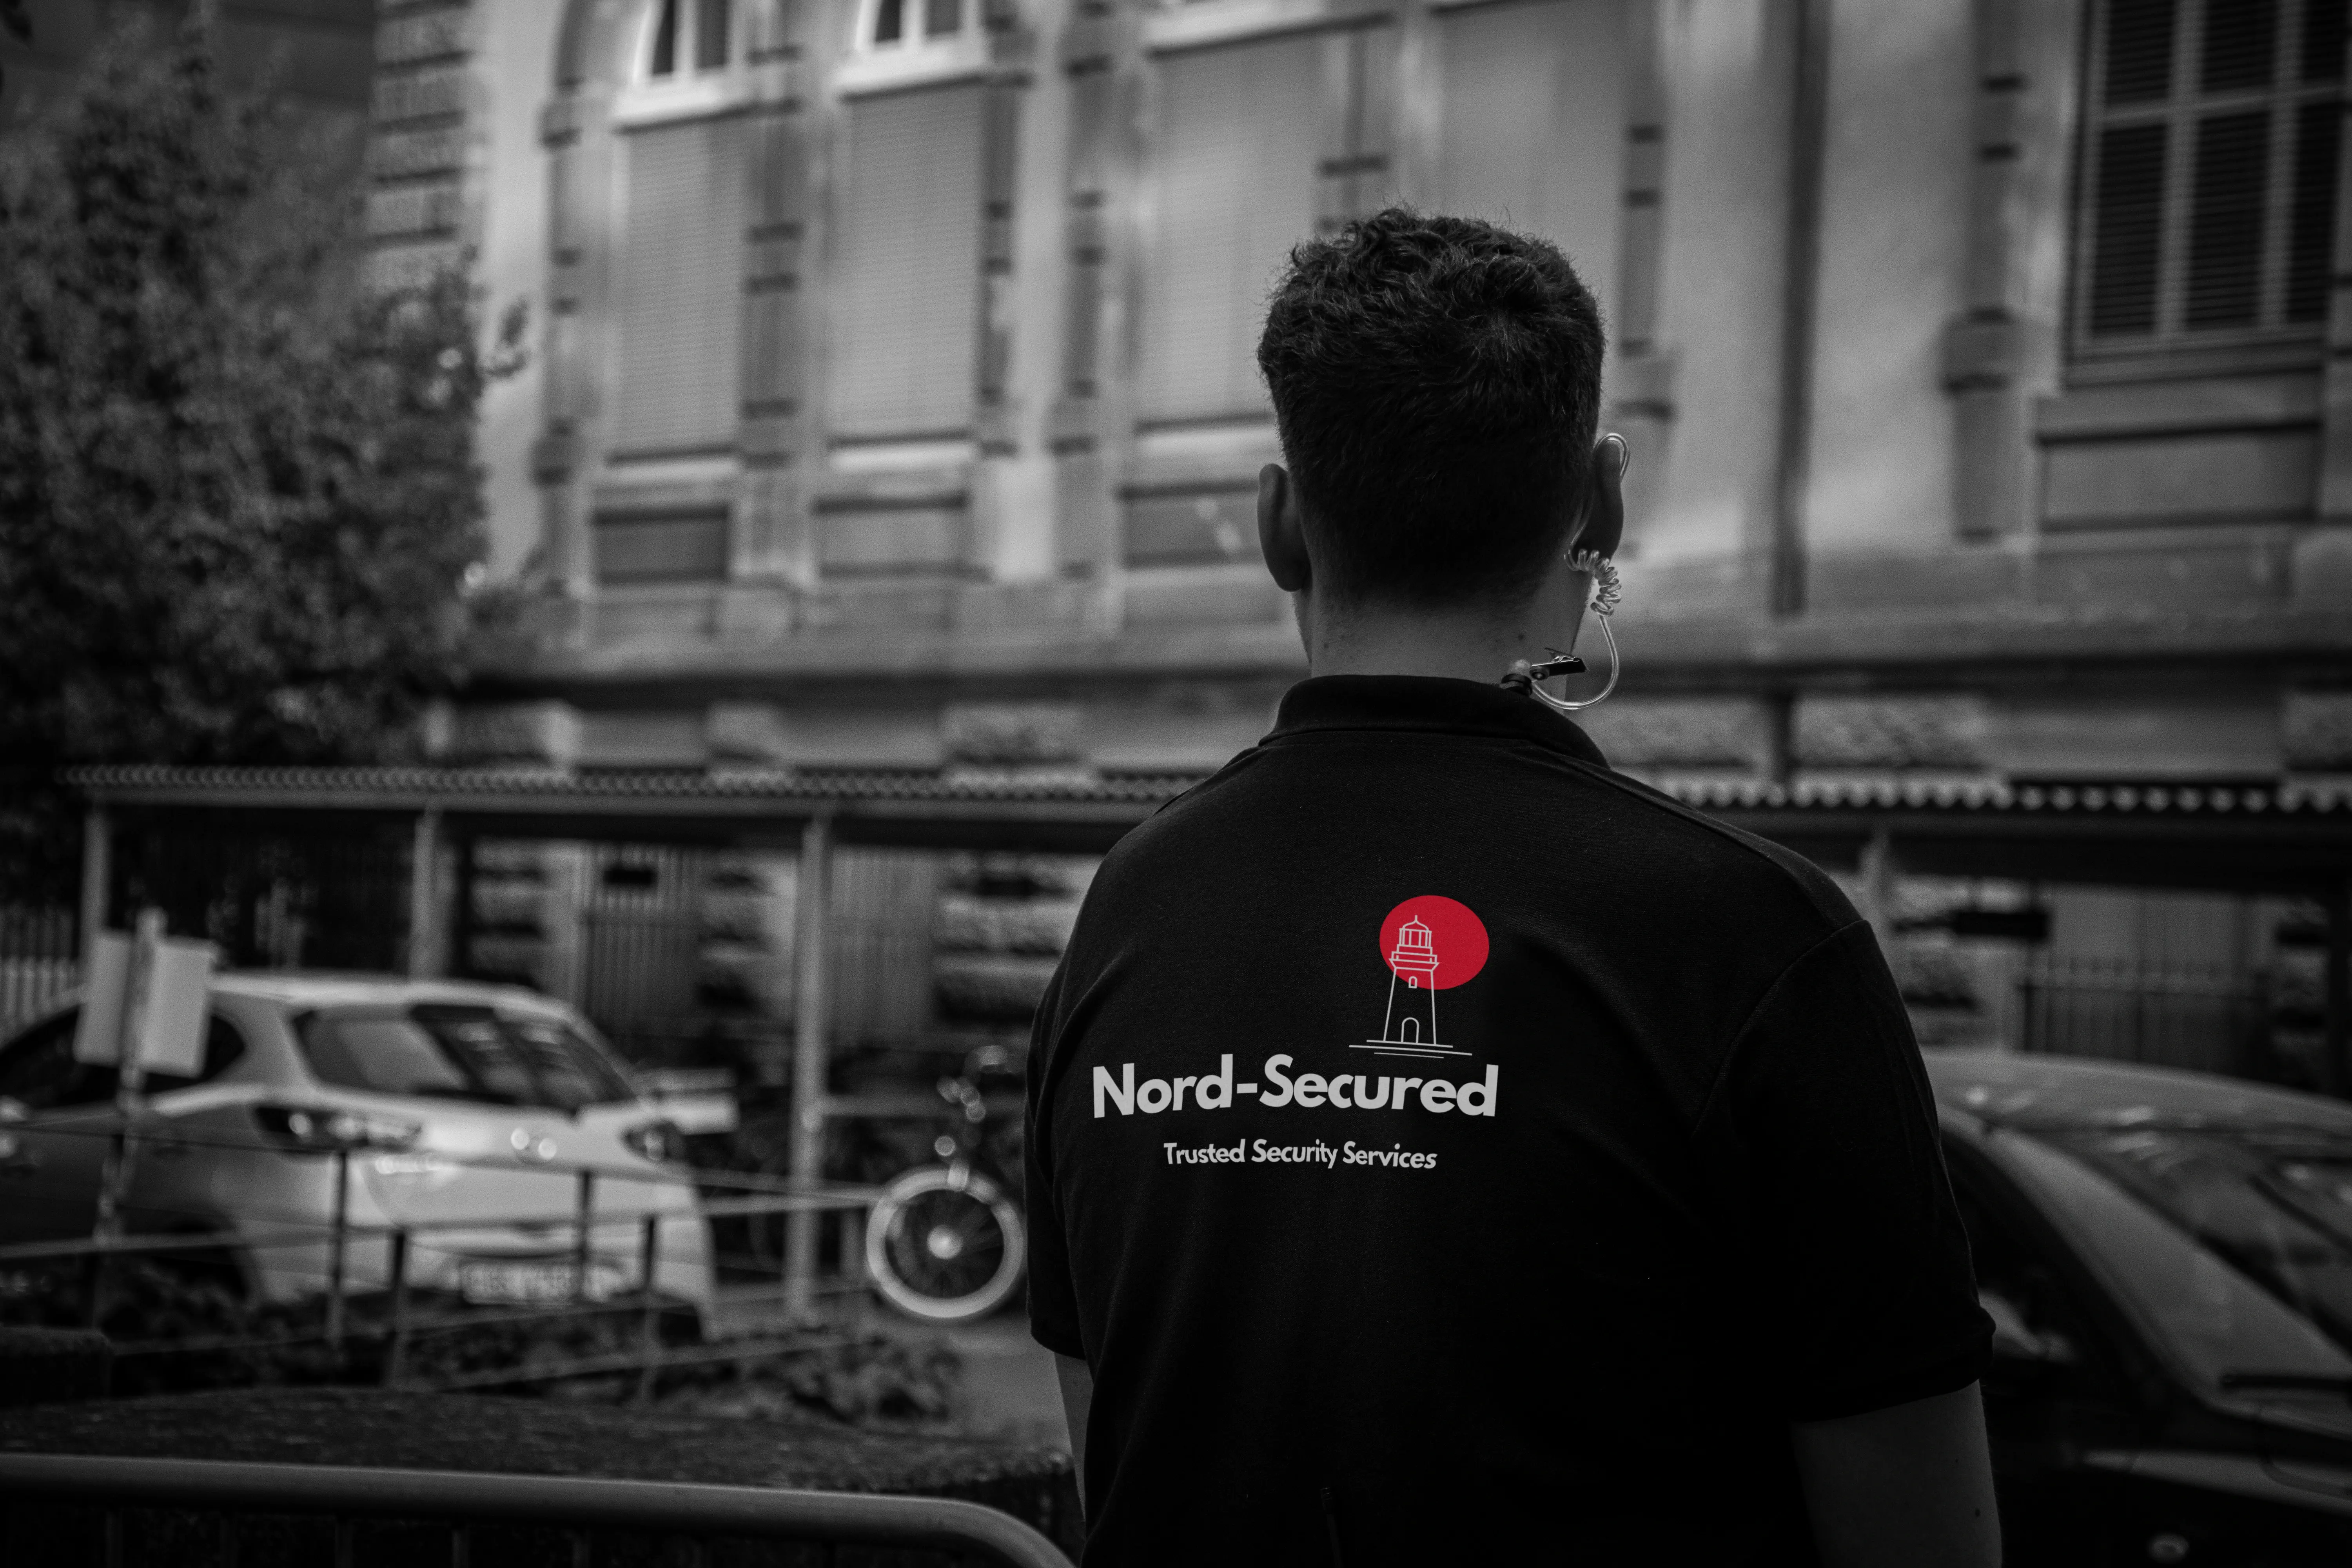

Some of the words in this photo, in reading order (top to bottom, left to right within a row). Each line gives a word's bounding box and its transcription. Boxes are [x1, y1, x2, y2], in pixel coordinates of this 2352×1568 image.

[1093, 1053, 1499, 1118] Nord-Secured
[1163, 1138, 1245, 1164] Trusted
[1251, 1138, 1338, 1169] Security
[1342, 1141, 1437, 1169] Services
